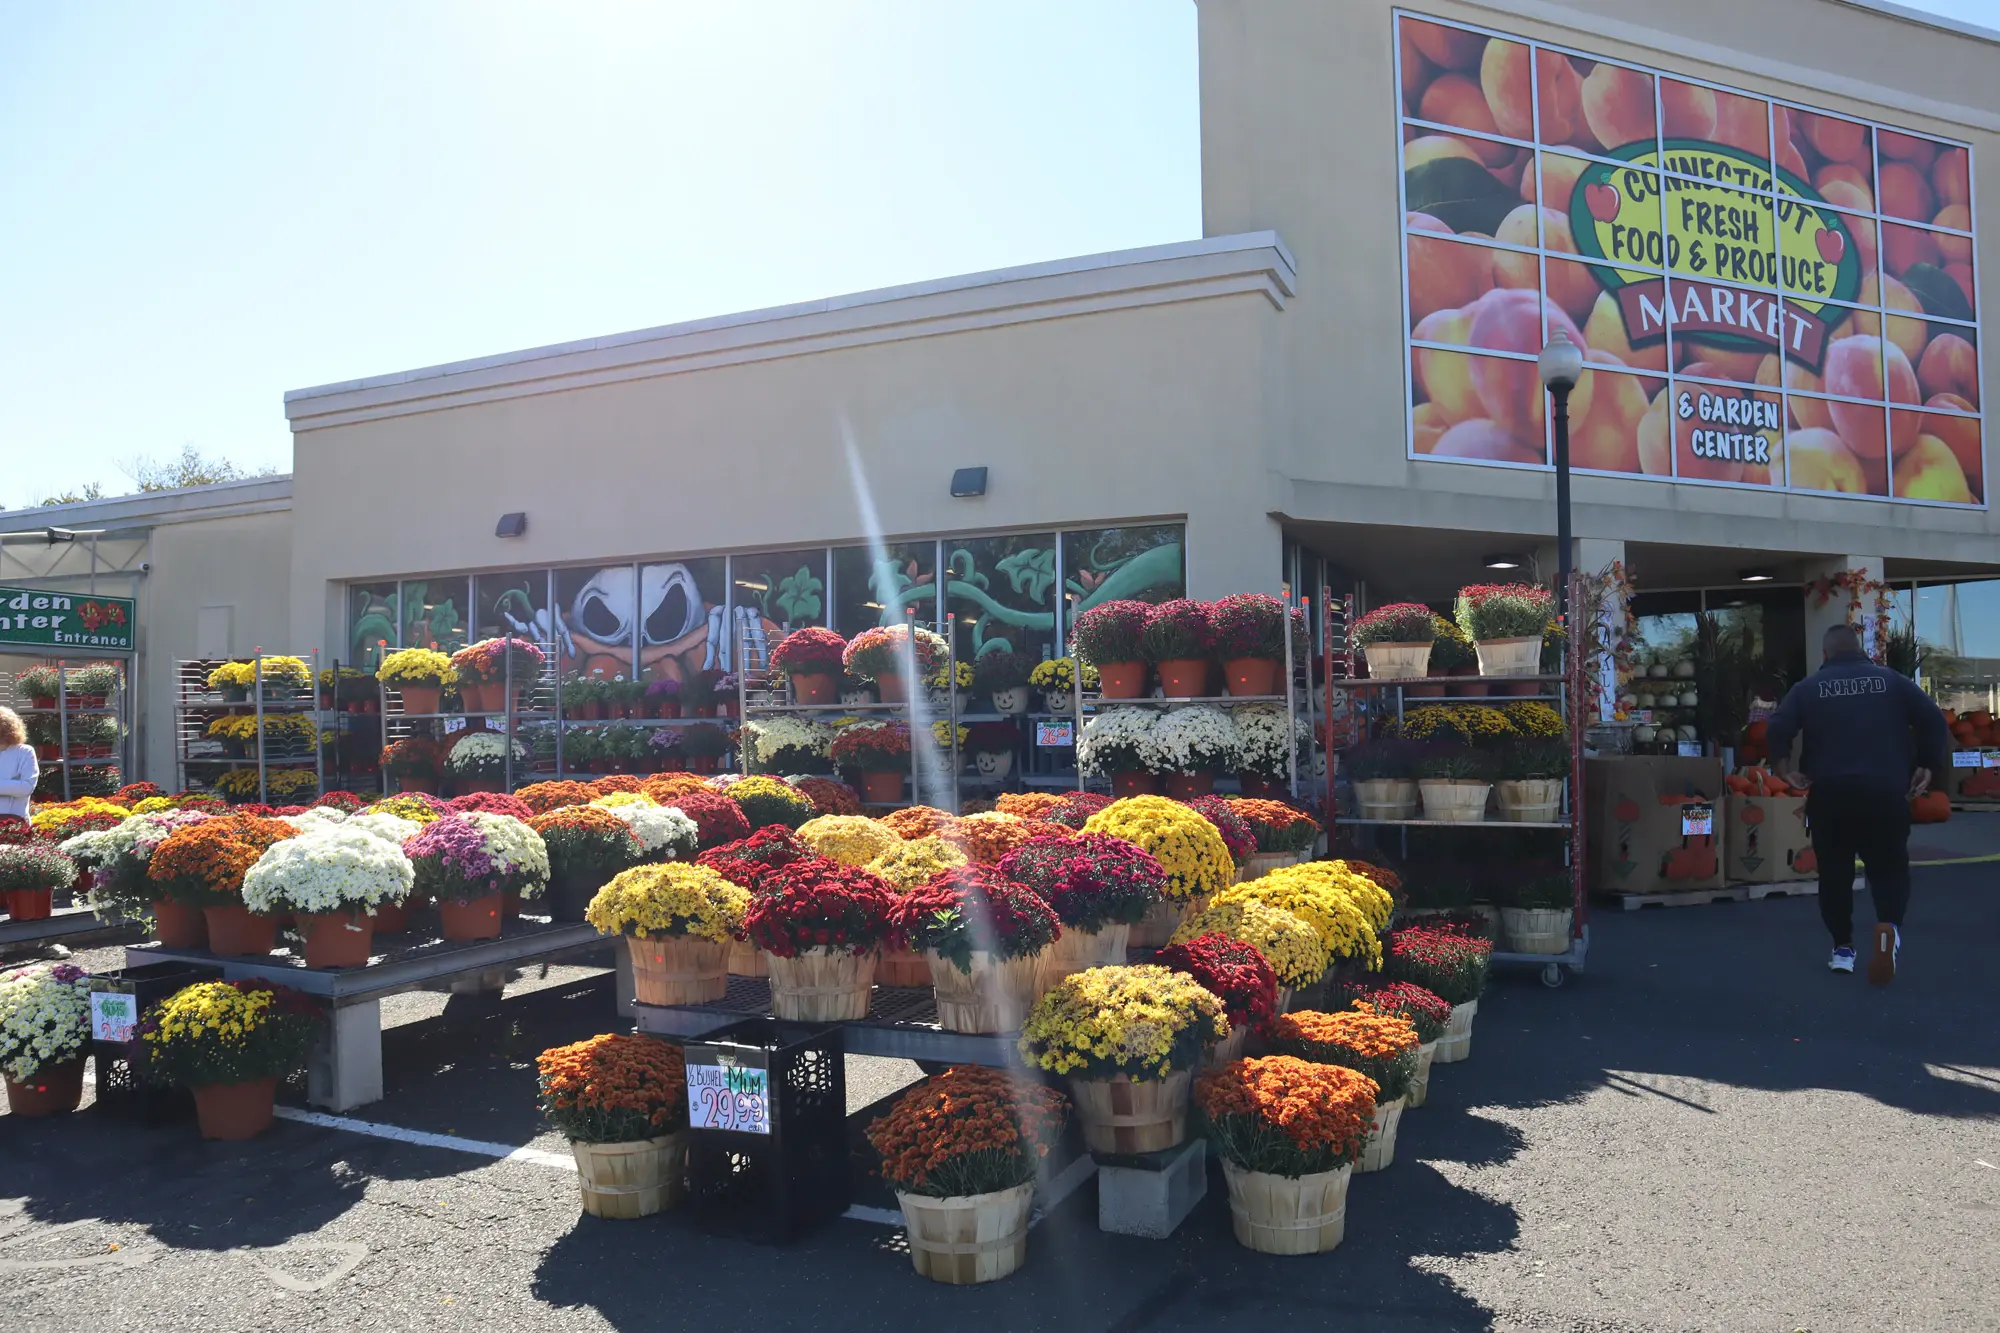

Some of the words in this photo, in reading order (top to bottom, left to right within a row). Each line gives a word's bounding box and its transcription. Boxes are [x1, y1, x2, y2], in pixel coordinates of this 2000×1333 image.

[1623, 156, 1813, 234] CONNECTICUT
[1681, 197, 1760, 244] FRESH
[1611, 223, 1680, 268] FOOD
[1688, 239, 1707, 272] &
[1714, 243, 1827, 293] PRODUCE
[1638, 286, 1813, 351] MARKET
[1678, 391, 1694, 419] &
[1698, 394, 1779, 429] GARDEN
[1691, 428, 1770, 463] CENTER
[54, 630, 127, 646] Entrance
[1819, 676, 1887, 698] NHFD
[728, 1065, 760, 1095] MUM
[701, 1087, 764, 1130] 29.99
